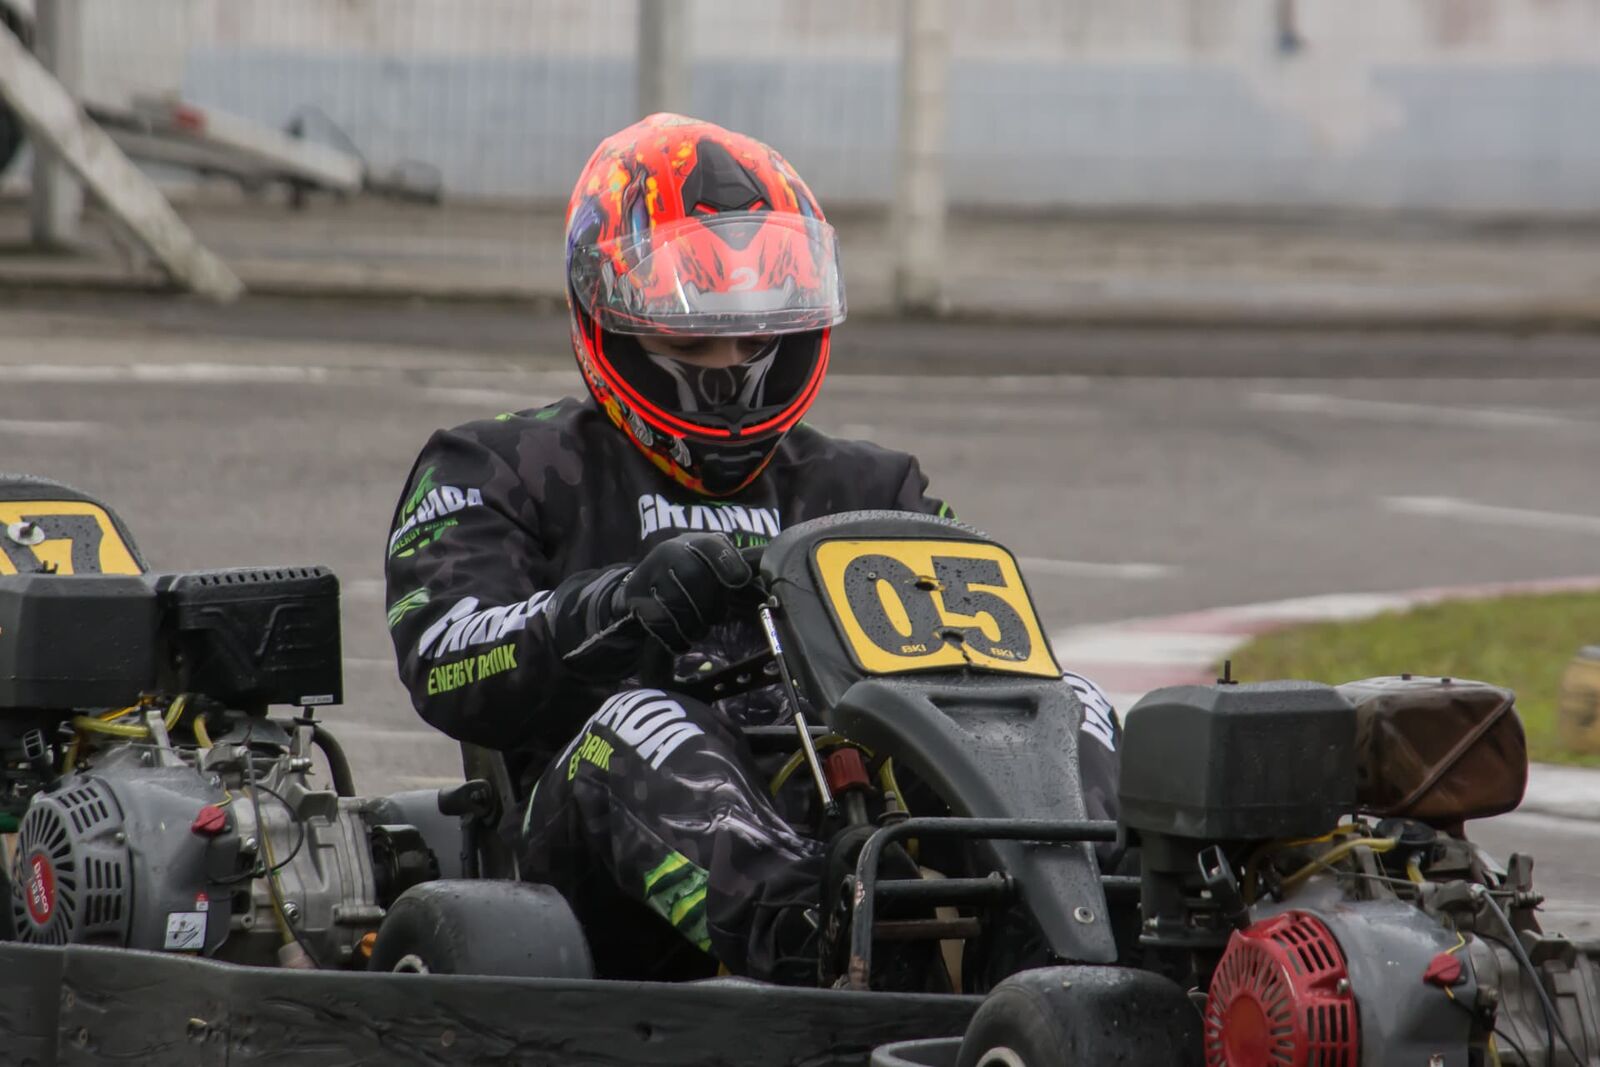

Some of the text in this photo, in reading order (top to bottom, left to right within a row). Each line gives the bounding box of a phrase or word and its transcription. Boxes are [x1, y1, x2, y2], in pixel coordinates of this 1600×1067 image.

[844, 554, 1031, 662] 05
[428, 643, 518, 696] ENERGY DRINK
